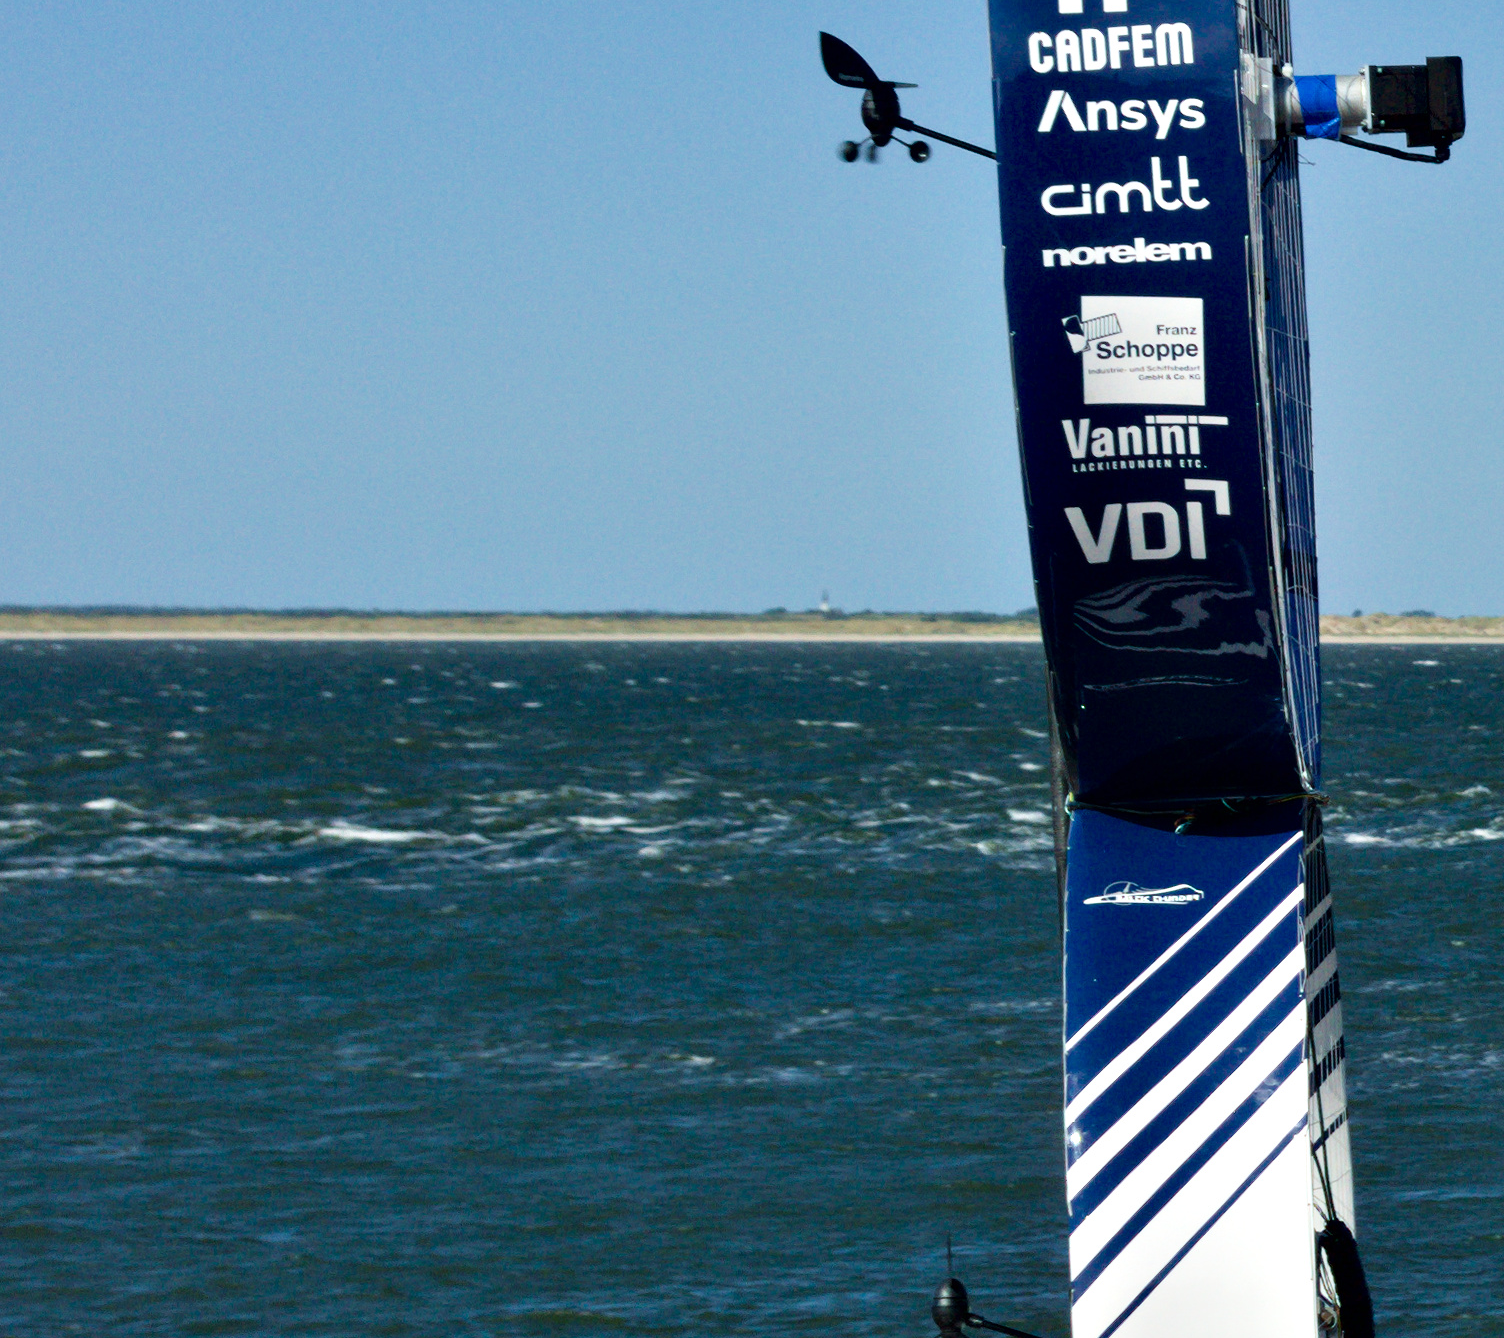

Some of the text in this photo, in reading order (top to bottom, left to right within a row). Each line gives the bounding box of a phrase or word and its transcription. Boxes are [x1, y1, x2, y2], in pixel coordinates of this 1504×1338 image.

[1028, 21, 1195, 74] CADFEM
[1037, 89, 1206, 140] Ansys
[1040, 155, 1211, 217] cimtt
[1042, 237, 1213, 268] norelem
[1095, 339, 1199, 362] Schoppe
[1156, 324, 1198, 336] Franz
[1061, 415, 1202, 460] Vanini
[1072, 459, 1208, 473] LACKIERUNGEN ETC.
[1064, 501, 1207, 565] VDI
